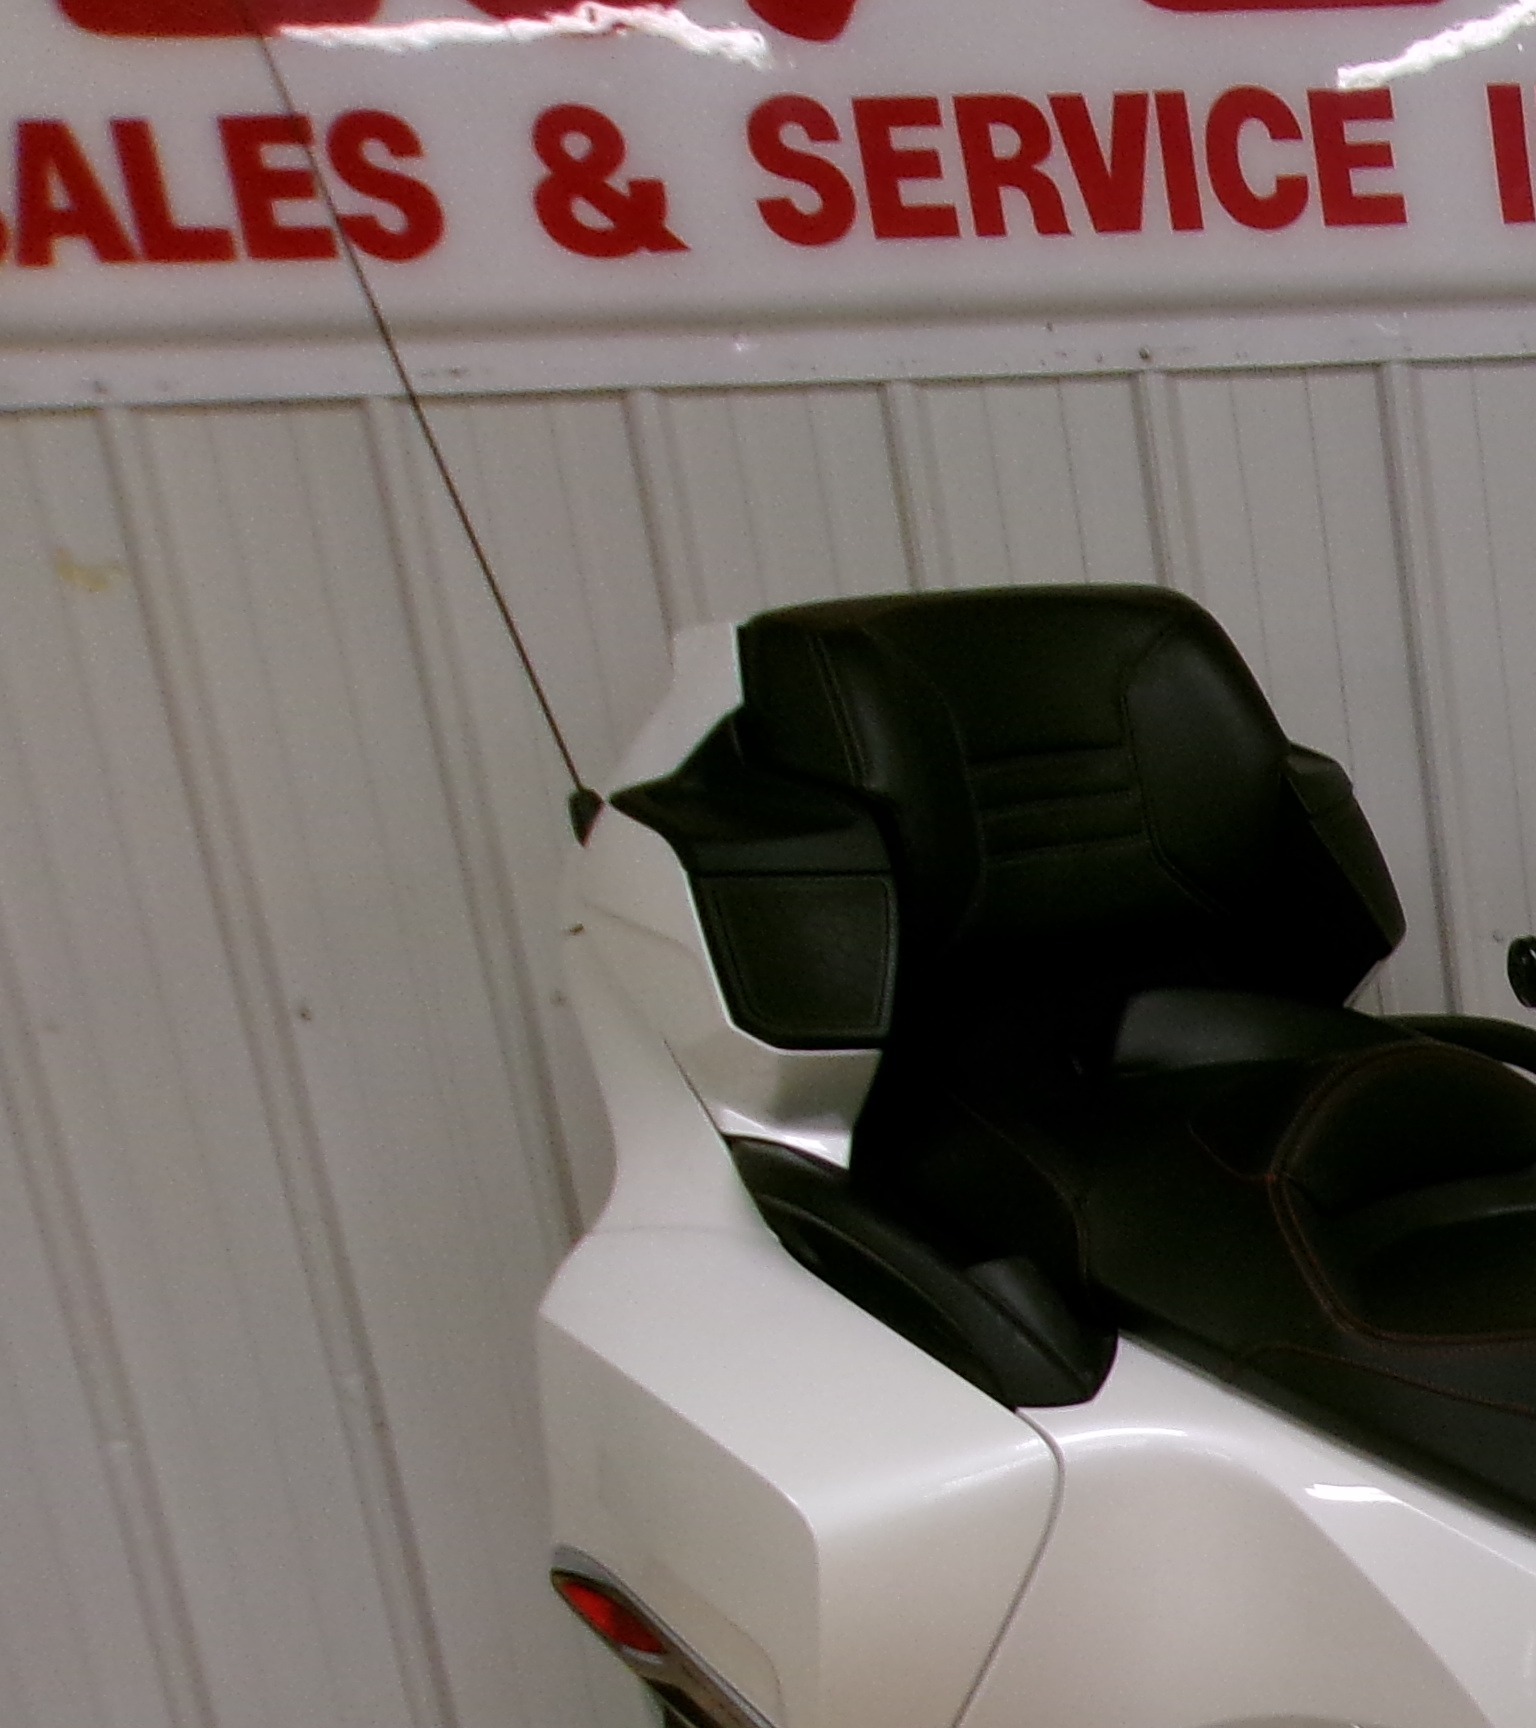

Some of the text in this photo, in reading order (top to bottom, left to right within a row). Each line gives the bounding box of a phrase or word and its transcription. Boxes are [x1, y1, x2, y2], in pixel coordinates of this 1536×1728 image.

[0, 110, 446, 268] ALES
[532, 104, 690, 259] &
[747, 87, 1408, 248] SERVICE
